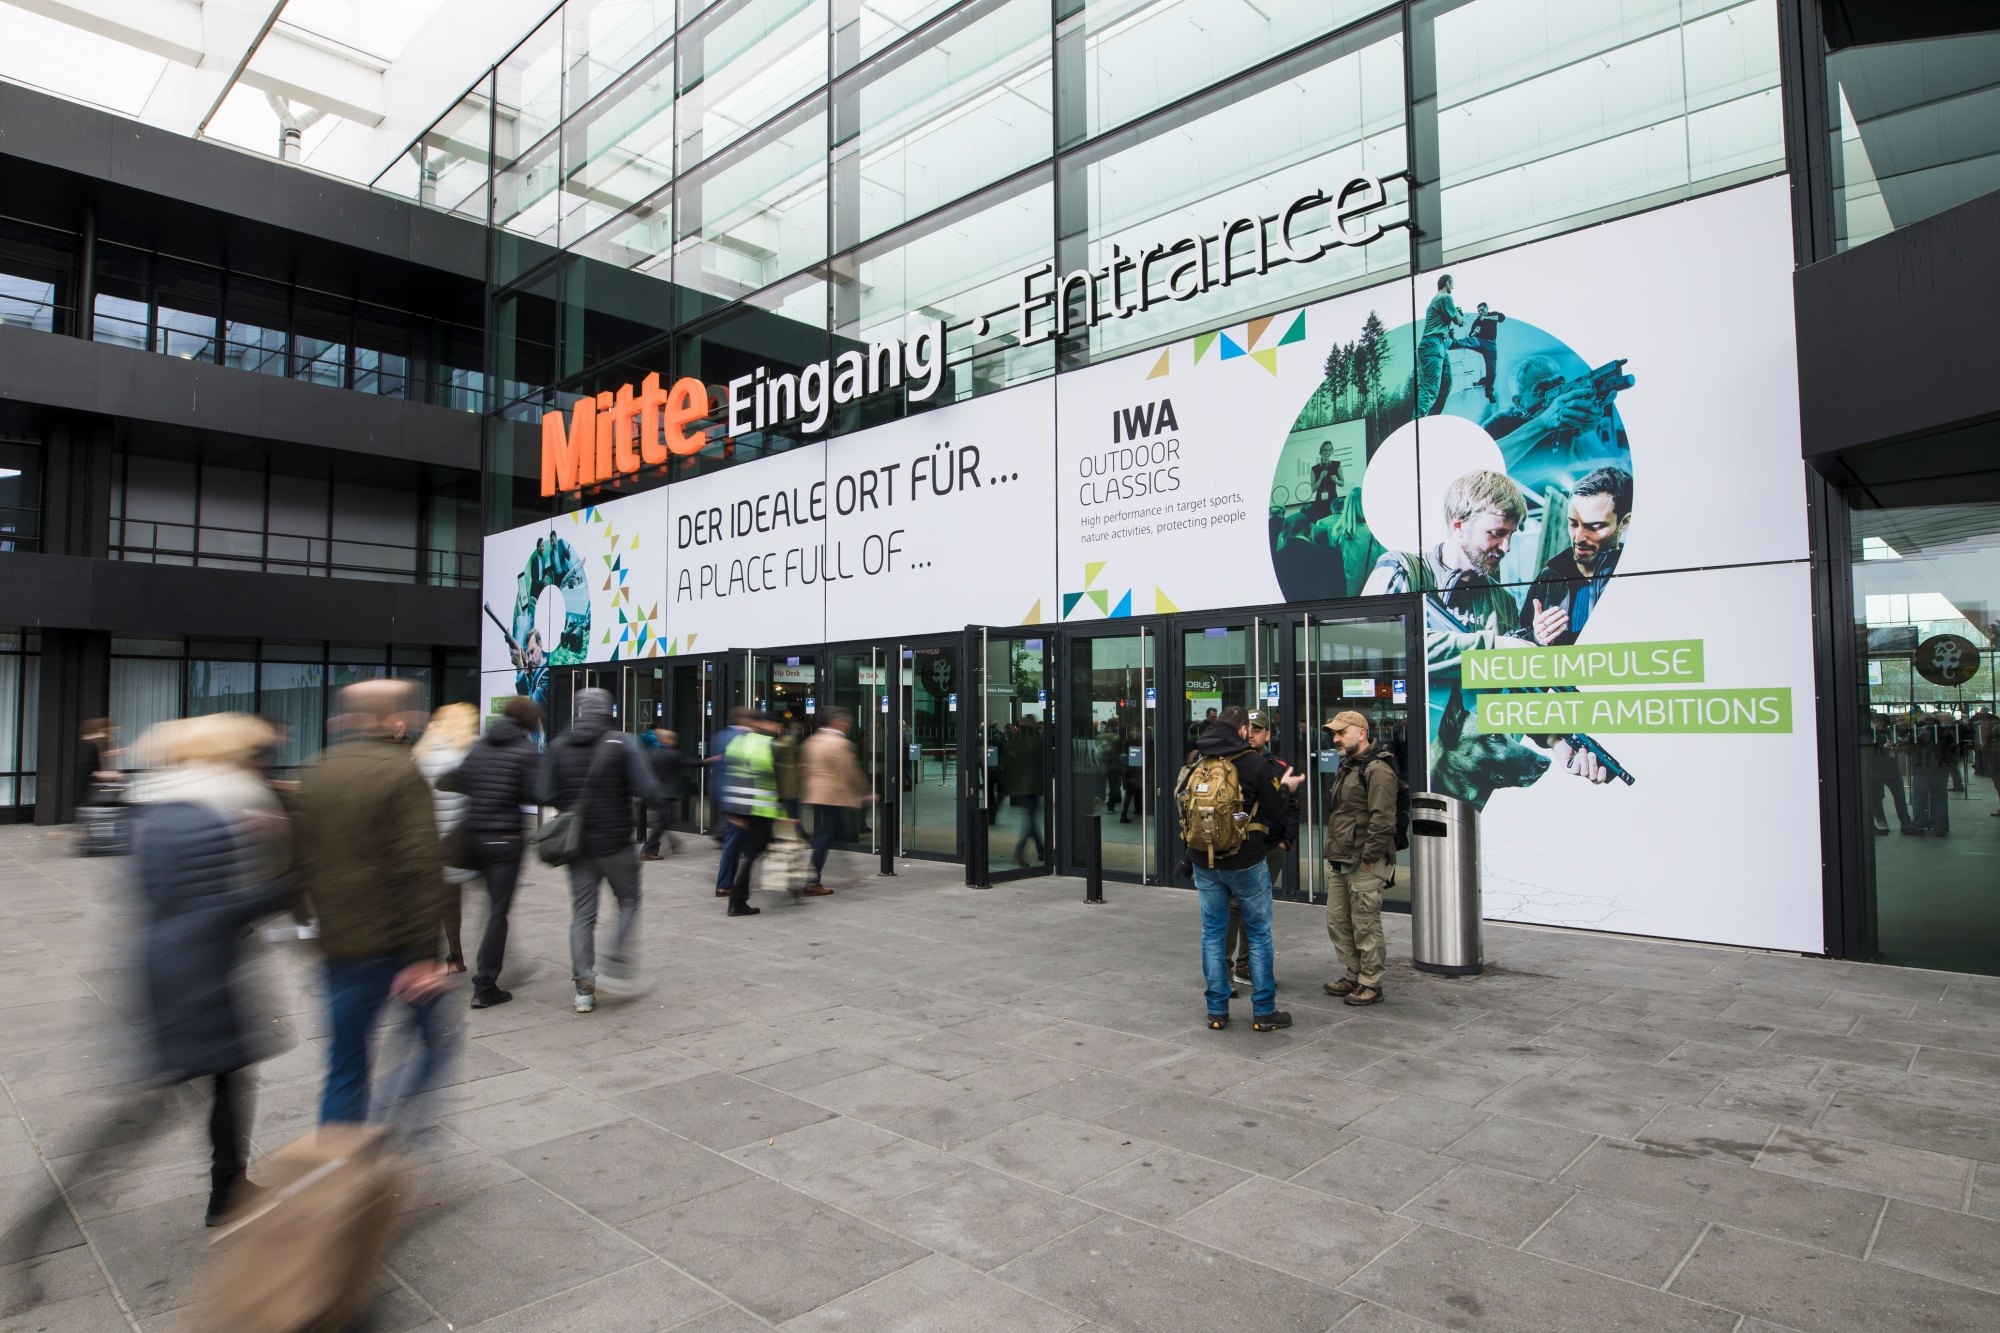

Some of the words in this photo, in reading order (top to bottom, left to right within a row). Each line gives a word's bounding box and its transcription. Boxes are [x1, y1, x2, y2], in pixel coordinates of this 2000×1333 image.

[540, 370, 711, 497] Mitte
[728, 320, 946, 437] Eingang
[1020, 170, 1387, 347] Entrance
[1113, 398, 1179, 444] IWA
[1079, 438, 1180, 478] OUTDOOR
[678, 507, 723, 549] DER
[730, 481, 827, 538] IDEALE
[835, 463, 901, 516] ORT
[911, 441, 982, 501] FÜR
[1079, 466, 1180, 506] CLASSICS
[1080, 514, 1101, 529] High
[1103, 506, 1163, 526] performance
[1165, 503, 1174, 514] in
[1177, 497, 1208, 513] target
[1209, 492, 1245, 508] sports,
[1080, 530, 1110, 543] nature
[1111, 523, 1154, 540] activities,
[1156, 515, 1207, 536] protecting
[1210, 509, 1246, 528] people
[677, 568, 693, 603] A
[700, 552, 777, 600] PLACE
[785, 540, 854, 587] FULL
[862, 529, 905, 576] OF
[785, 669, 801, 677] Desk
[1470, 654, 1547, 681] NEUE
[1553, 648, 1693, 678] IMPULSE
[1486, 700, 1583, 726] GREAT
[1591, 696, 1781, 726] AMBITIONS
